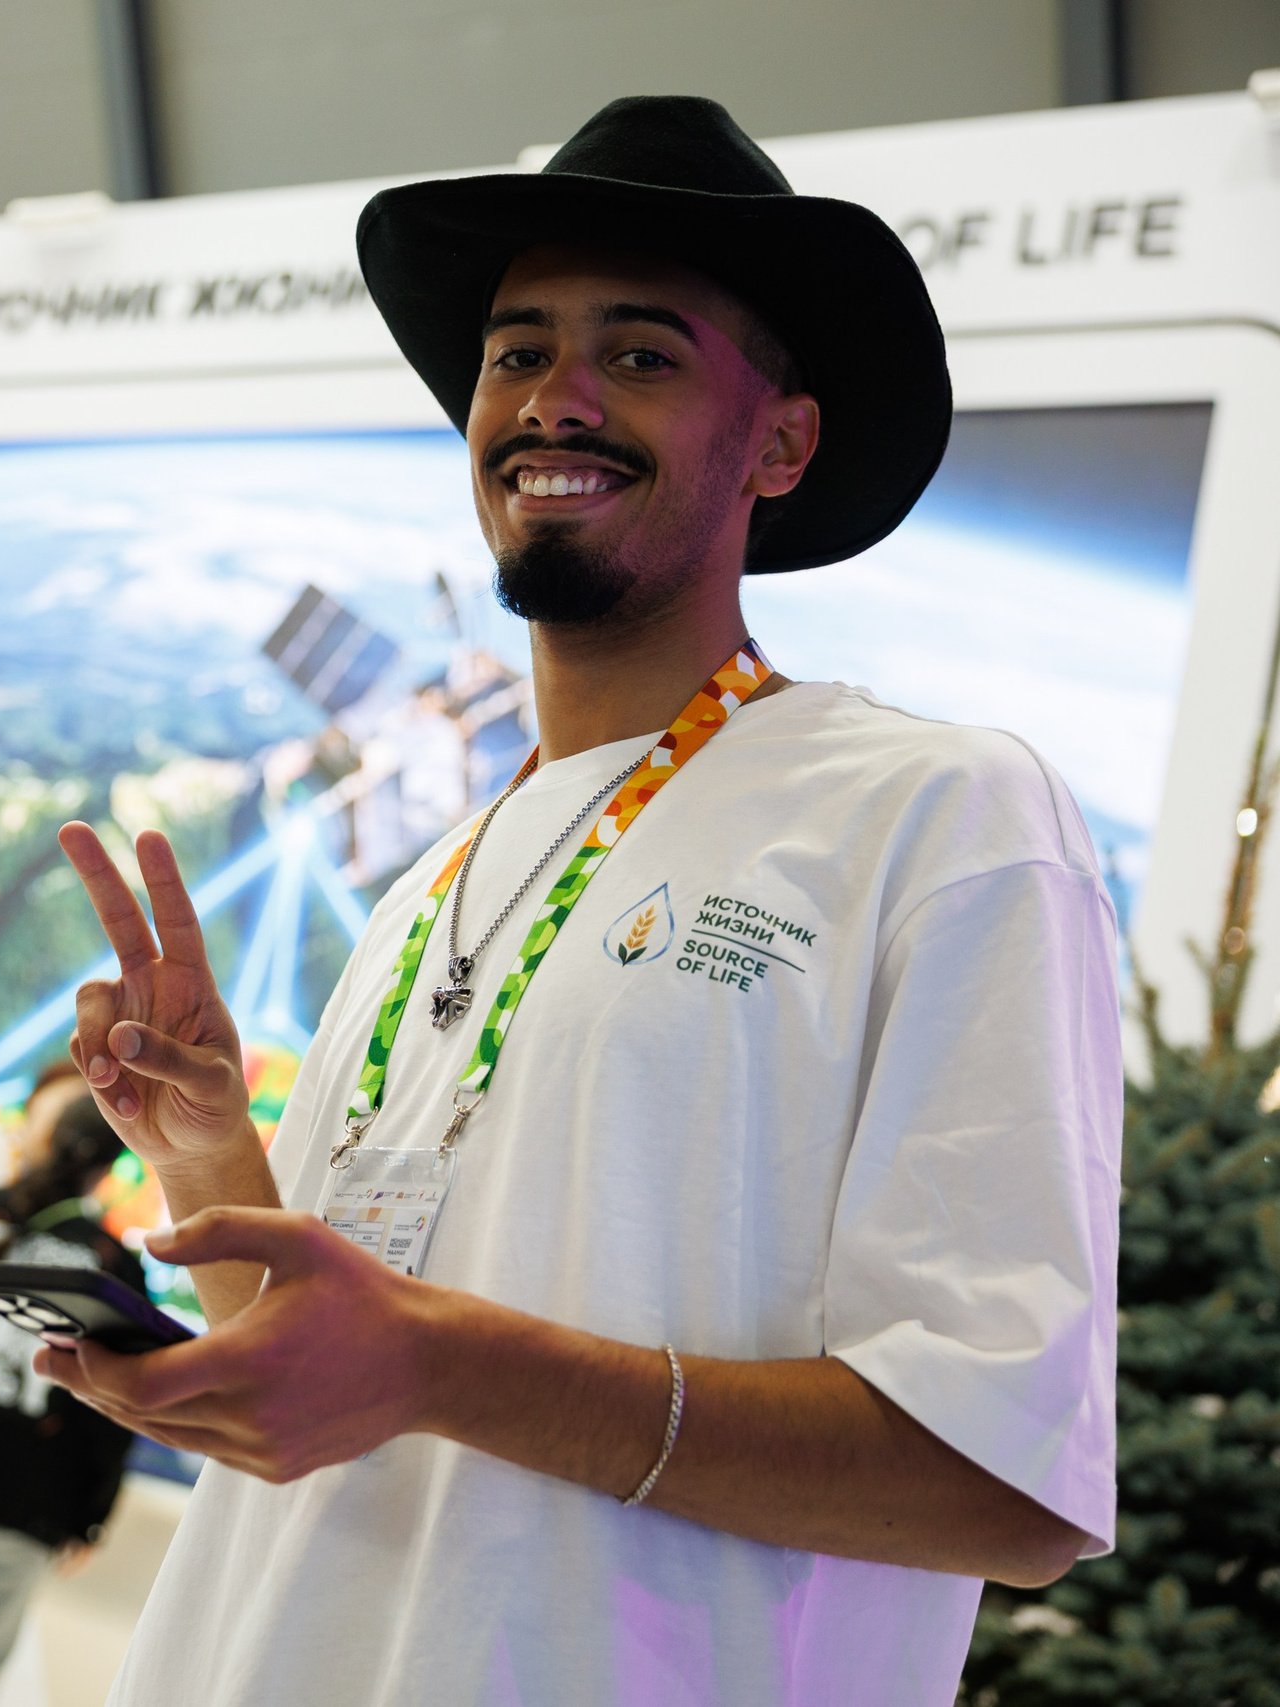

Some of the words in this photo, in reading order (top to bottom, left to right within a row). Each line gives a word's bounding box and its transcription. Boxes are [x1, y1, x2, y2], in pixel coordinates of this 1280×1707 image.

[902, 210, 989, 270] OF
[1016, 193, 1183, 267] LIFE
[694, 910, 776, 945] ЖИЗНИ
[703, 894, 818, 948] ИСТОЧНИК
[675, 956, 706, 975] OF
[708, 964, 753, 993] LIFE
[682, 939, 769, 979] SOURCE
